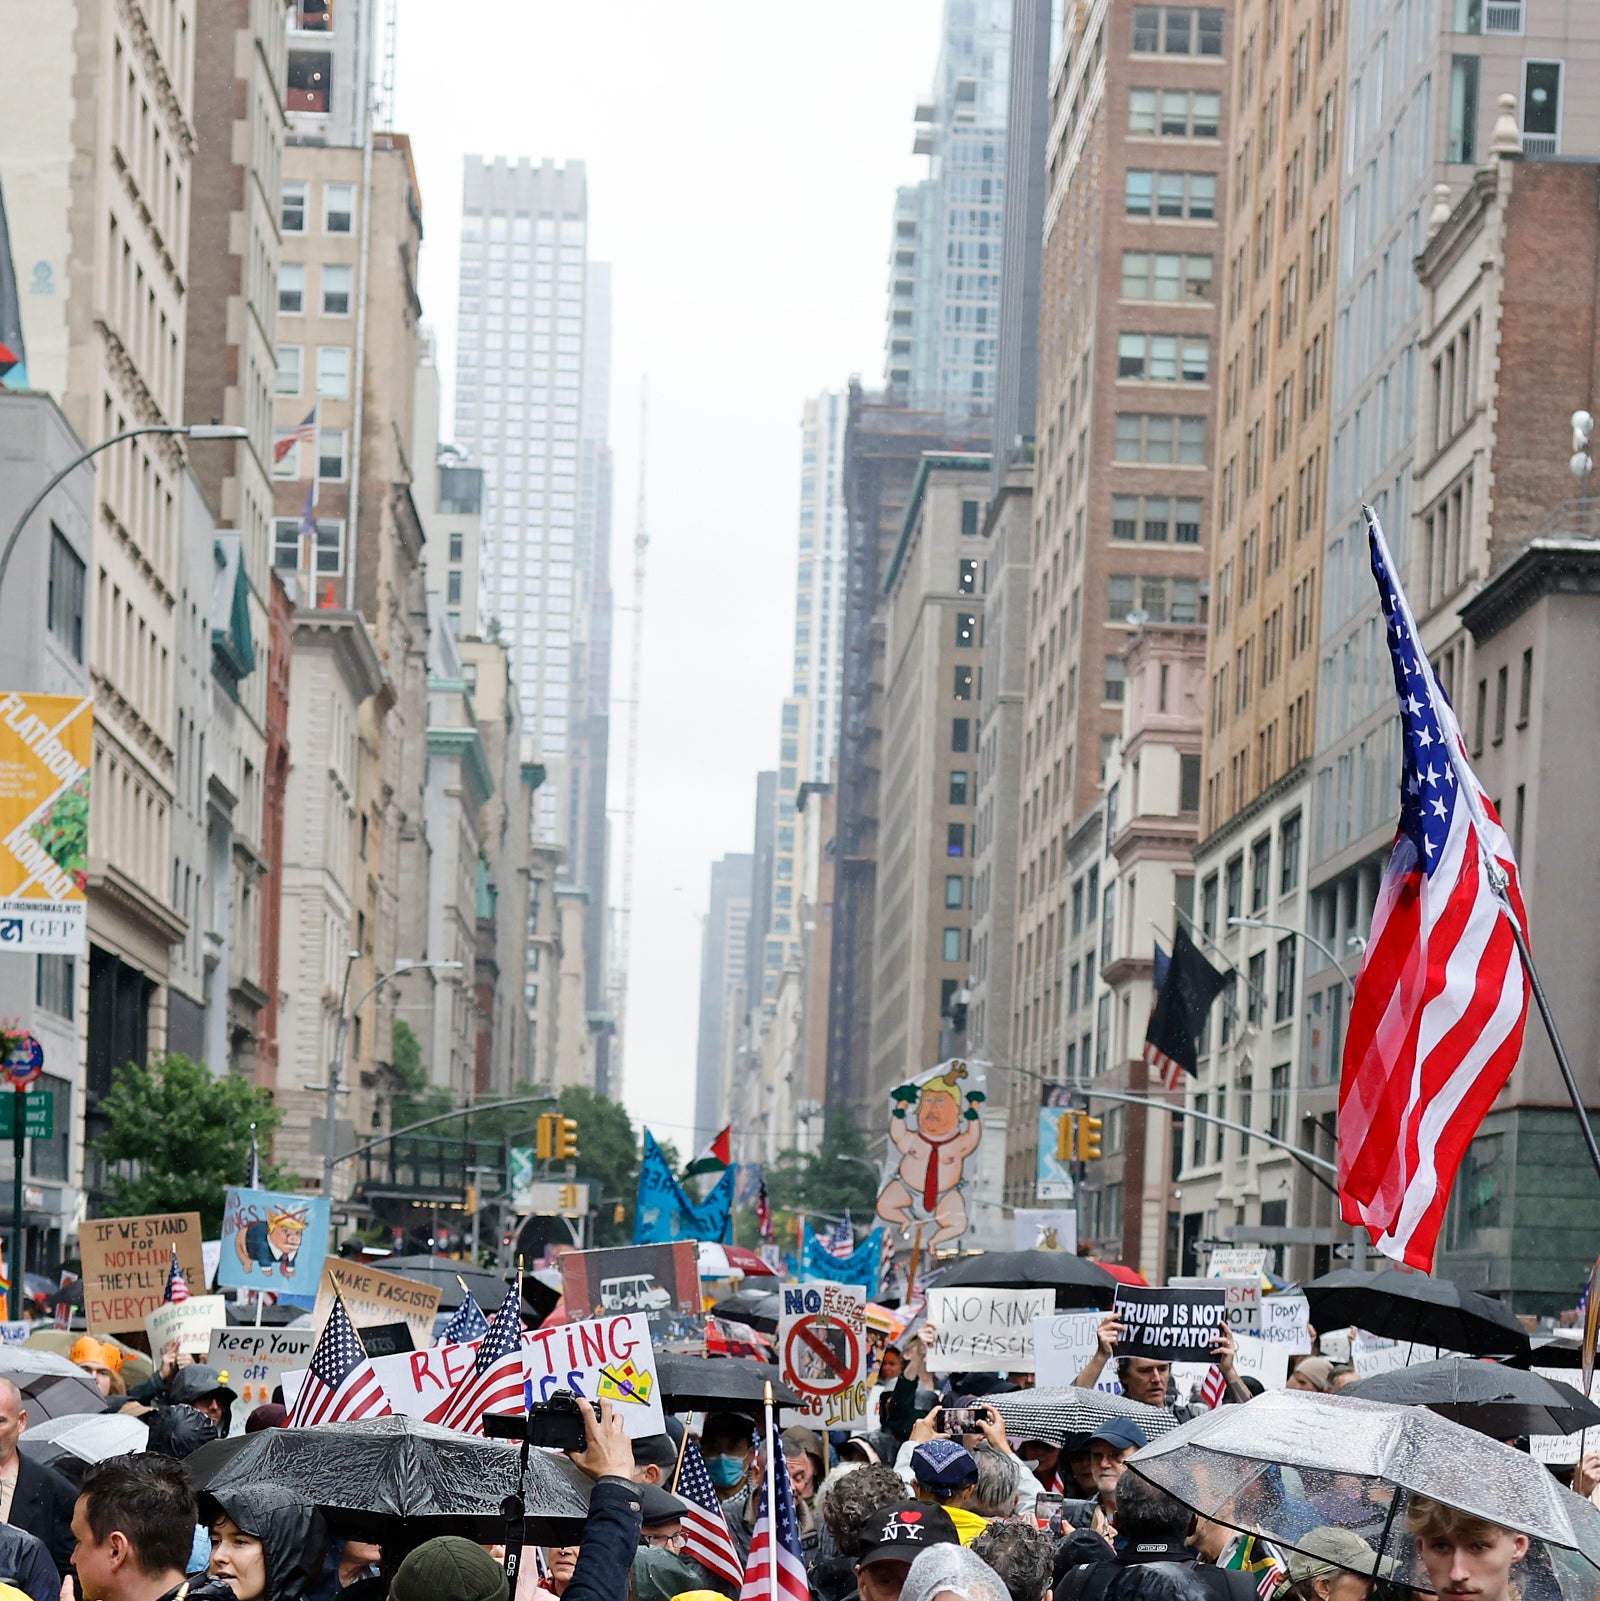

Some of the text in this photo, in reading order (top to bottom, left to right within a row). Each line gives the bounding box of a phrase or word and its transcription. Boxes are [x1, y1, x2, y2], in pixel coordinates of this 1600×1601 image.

[2, 826, 75, 900] NOMAD
[30, 918, 75, 938] GFP
[96, 1218, 188, 1242] IF WE STAND
[131, 1240, 154, 1250] FOR
[335, 1269, 437, 1310] MAKE FASCISTS
[784, 1288, 822, 1316] NO
[1116, 1300, 1169, 1327] TRUMP
[1172, 1304, 1188, 1326] IS
[1189, 1305, 1225, 1327] NOT
[1268, 1303, 1301, 1323] TODAY
[218, 1331, 265, 1356] Keep
[270, 1331, 311, 1355] Your
[243, 1366, 269, 1380] off
[825, 1381, 868, 1427] 1776
[507, 1554, 517, 1577] EOS
